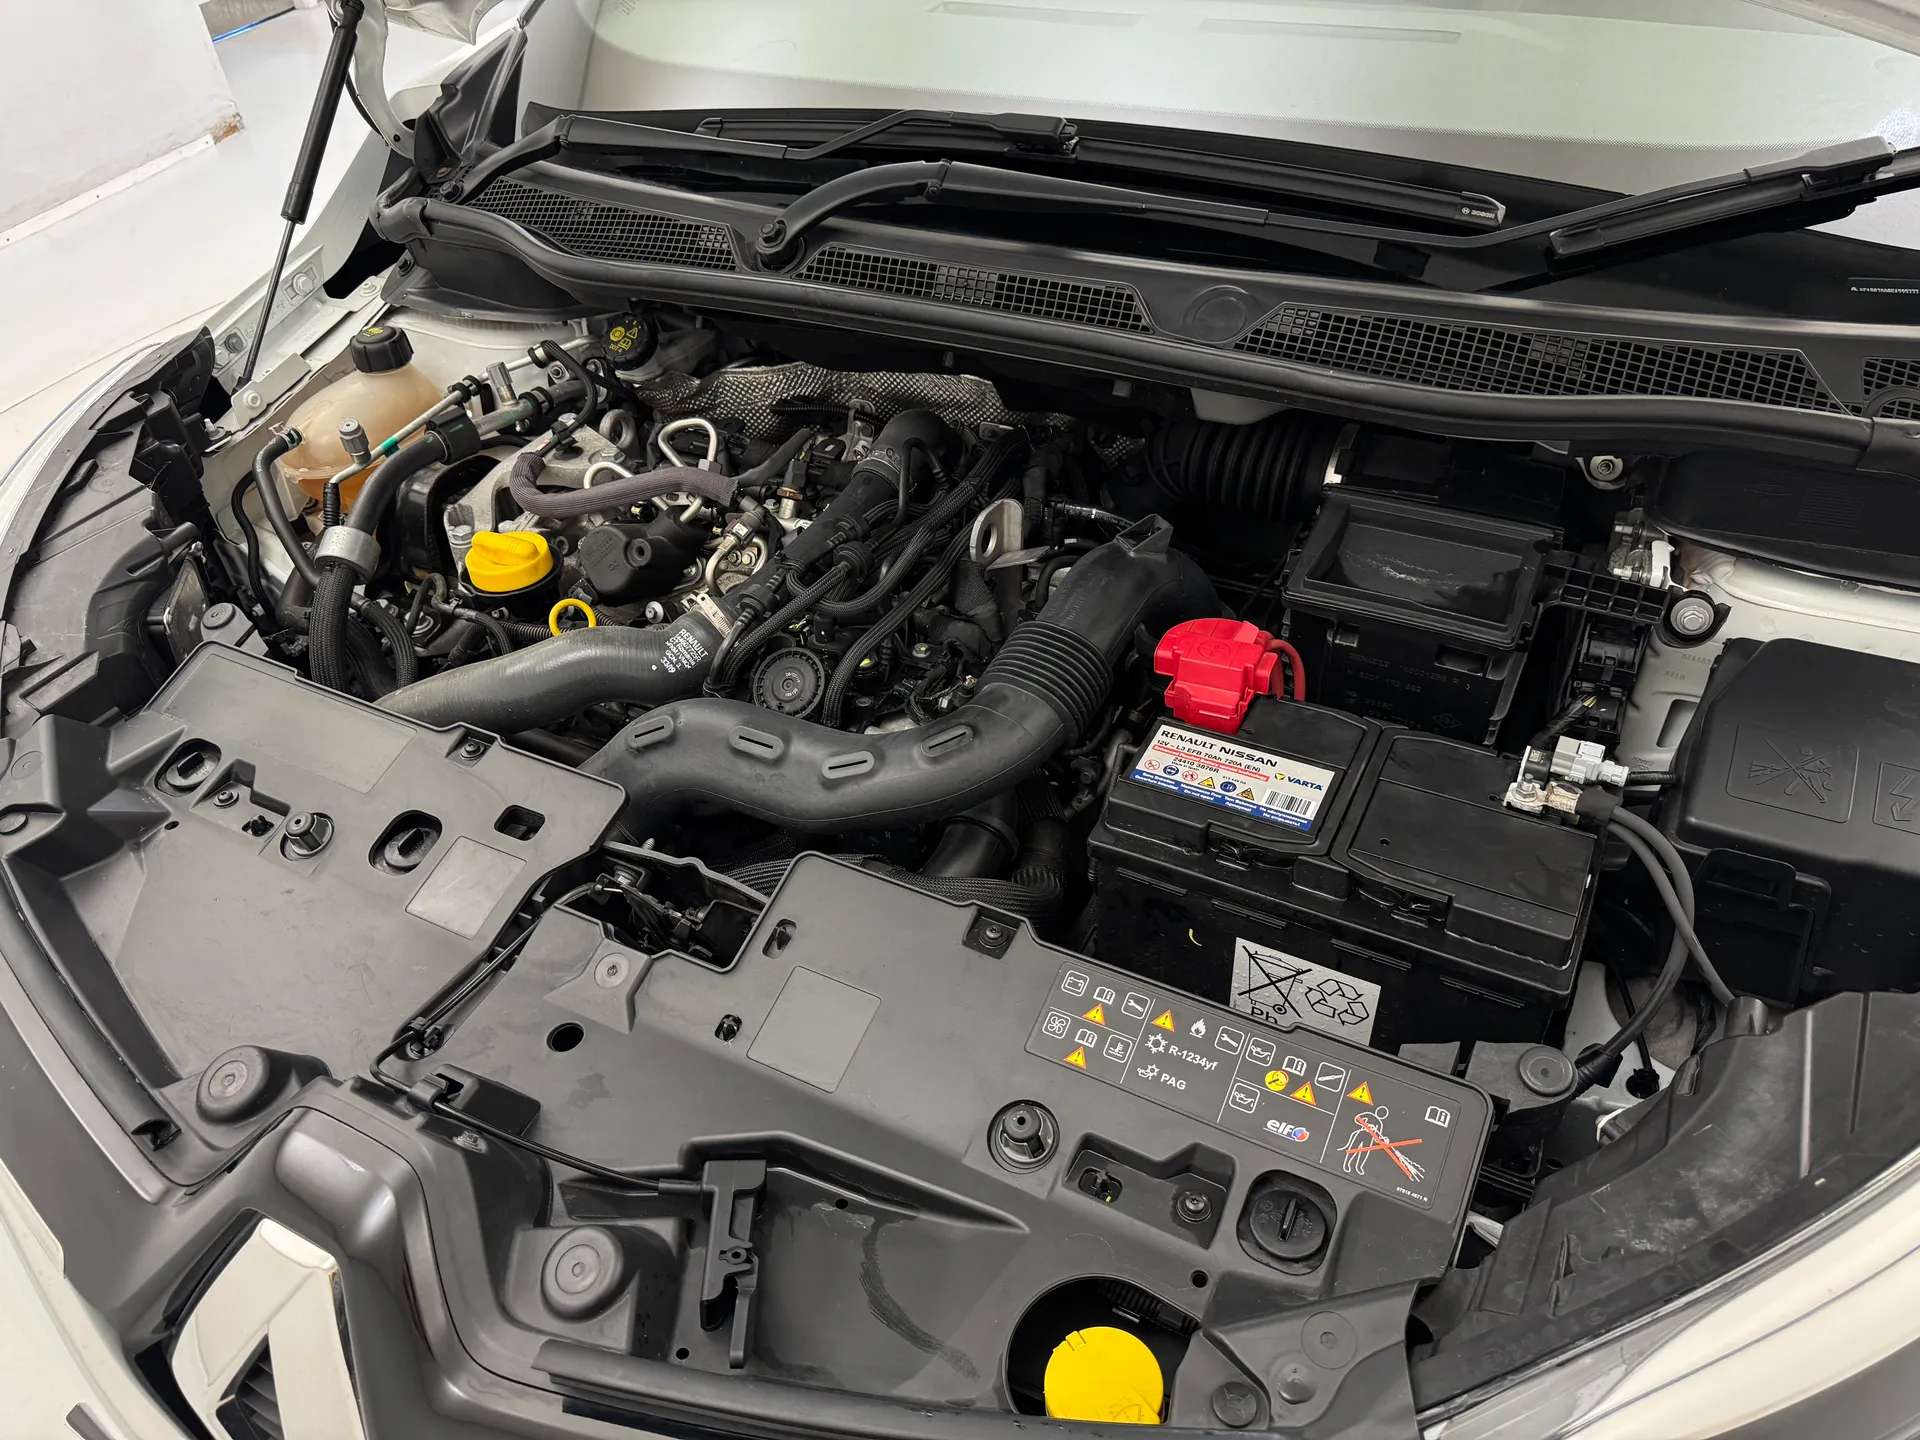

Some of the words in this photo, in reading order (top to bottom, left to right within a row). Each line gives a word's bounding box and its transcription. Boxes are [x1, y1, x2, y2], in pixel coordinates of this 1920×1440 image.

[679, 628, 709, 658] RENAULT
[1160, 730, 1216, 750] RENAULT
[1218, 746, 1277, 767] NISSAN
[1172, 756, 1194, 766] 24410
[1186, 747, 1202, 755] EFB
[1203, 752, 1223, 761] 70Ah
[1224, 758, 1243, 767] 720A
[1243, 763, 1261, 772] (EN)
[1286, 775, 1322, 791] VARTA
[1168, 1045, 1219, 1071] R-1234yf
[1160, 1073, 1187, 1090] PAG
[1265, 1119, 1296, 1136] elf
